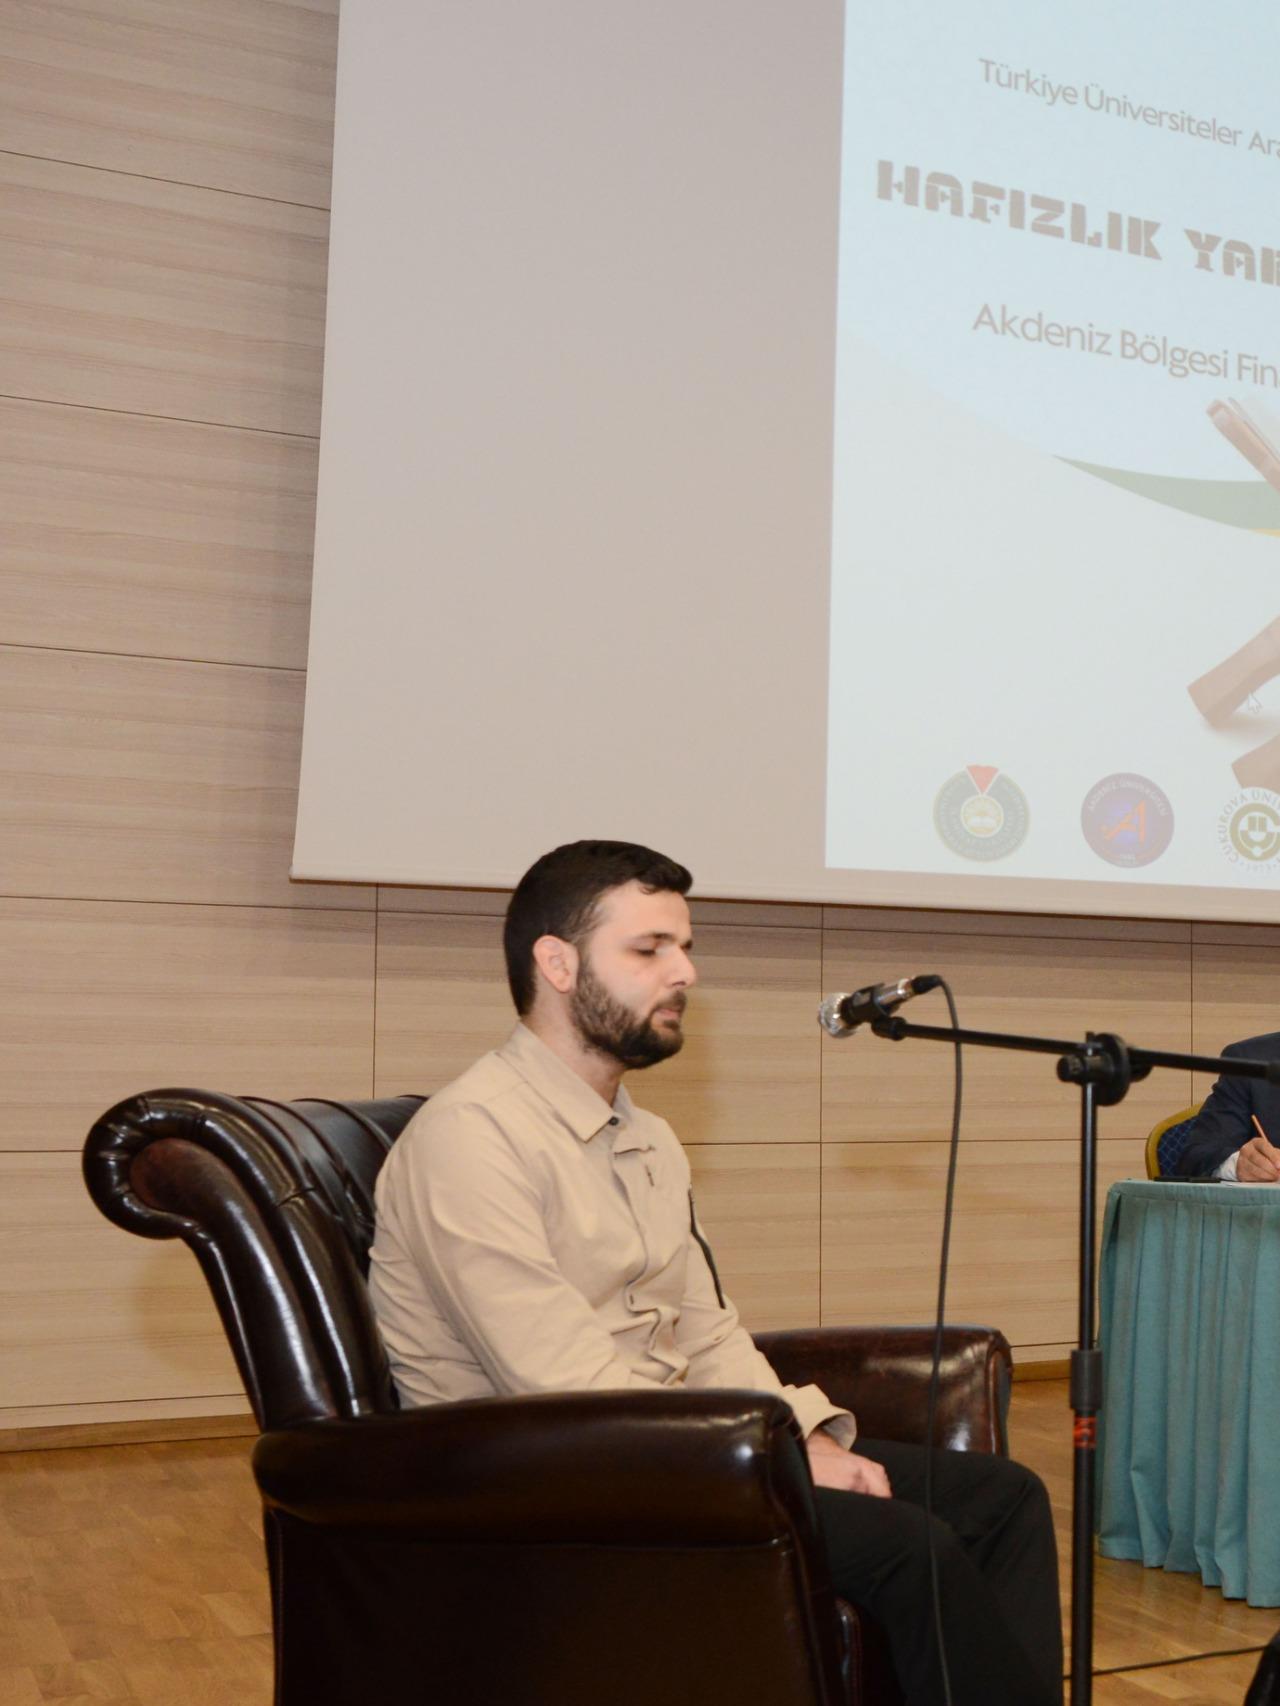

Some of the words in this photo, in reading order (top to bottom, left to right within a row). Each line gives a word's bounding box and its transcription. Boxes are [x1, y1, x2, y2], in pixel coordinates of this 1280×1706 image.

[979, 58, 1078, 106] Türkiye
[1084, 83, 1242, 146] Üniversiteler
[877, 159, 1162, 260] HAFIZLIK
[972, 303, 1112, 355] Akdeniz
[1120, 328, 1228, 378] Bölgesi
